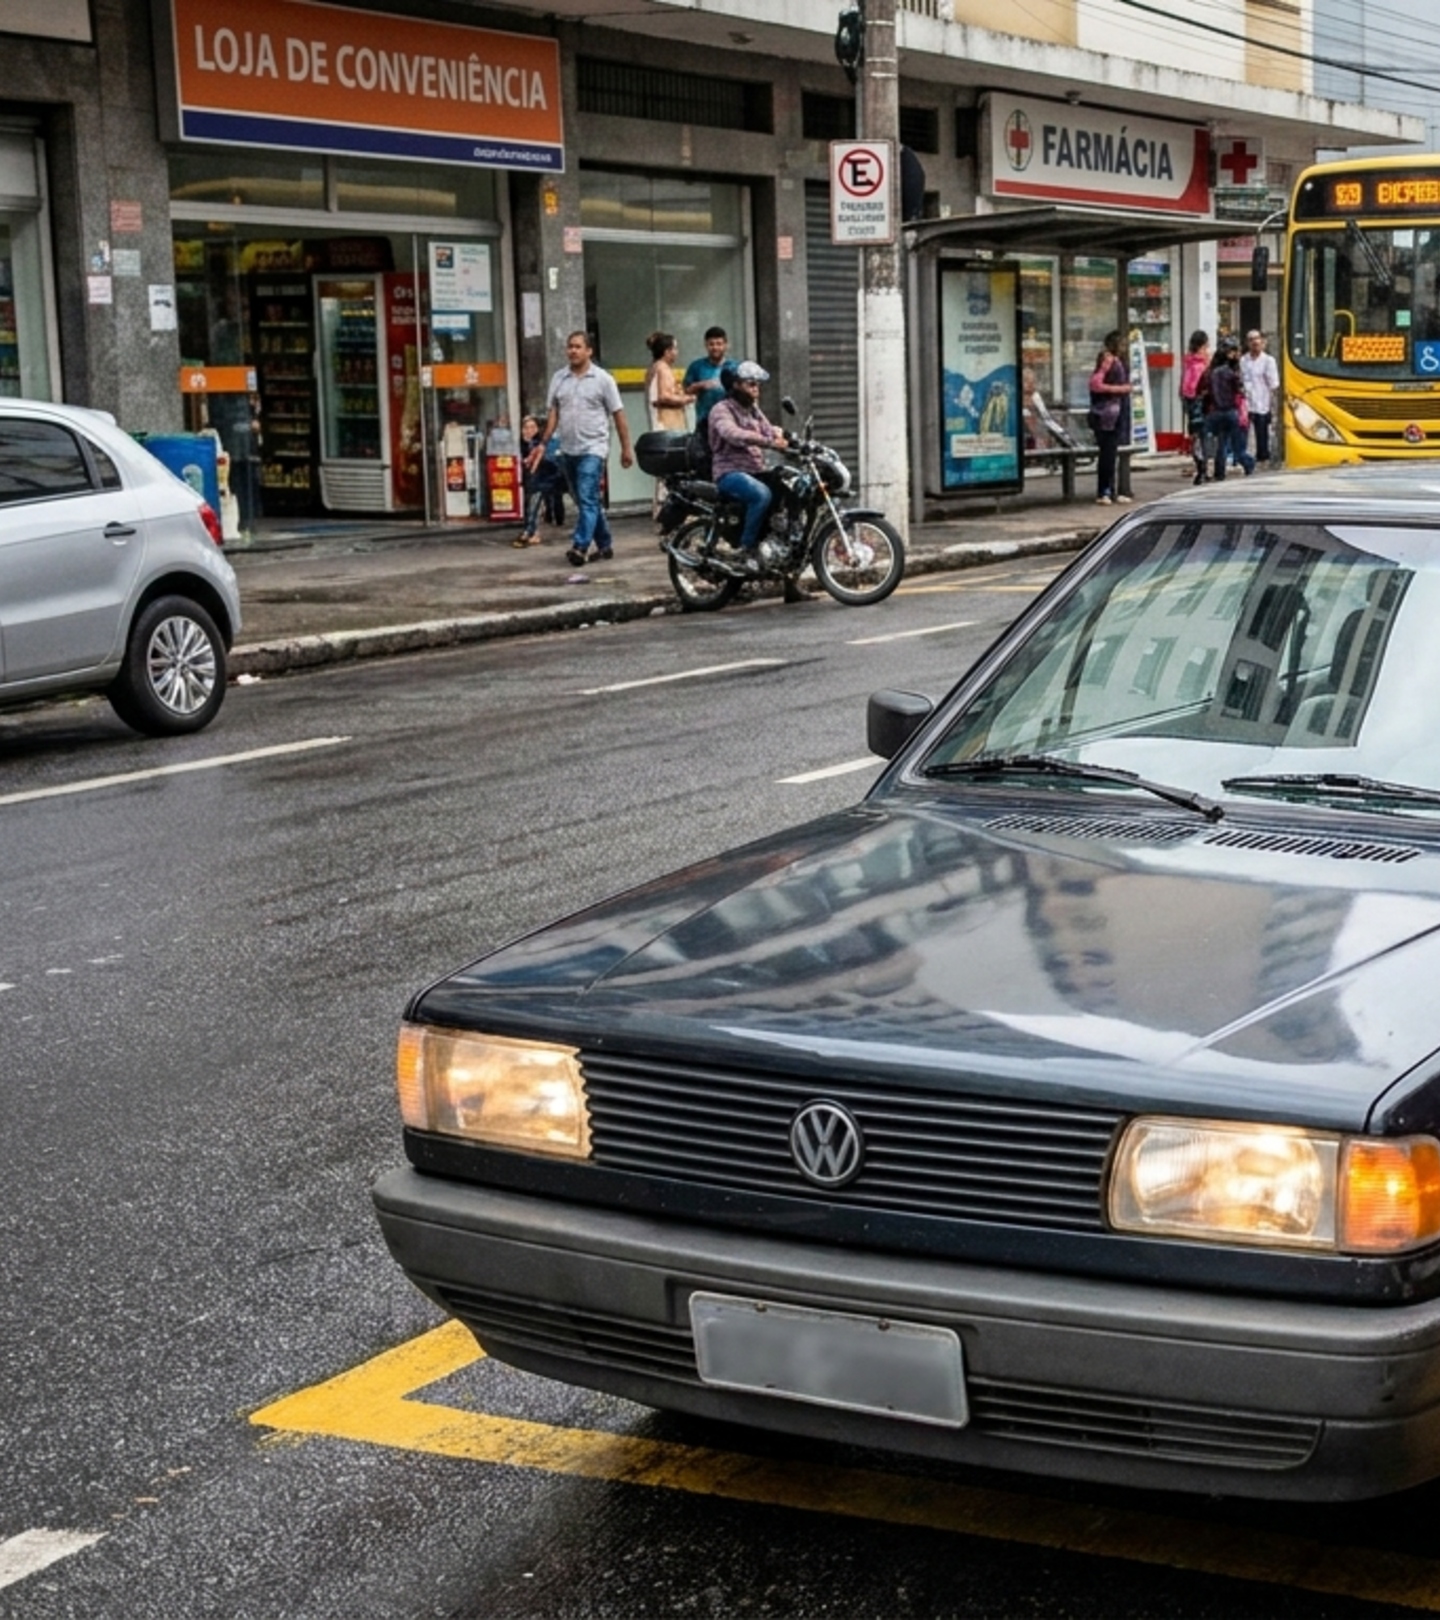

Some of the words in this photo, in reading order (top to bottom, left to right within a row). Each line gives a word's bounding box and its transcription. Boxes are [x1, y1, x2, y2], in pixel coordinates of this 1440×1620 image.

[195, 25, 278, 79] LOJA
[286, 37, 329, 85] DE
[336, 44, 548, 110] CONVENIÊNCIA
[847, 157, 875, 187] E
[1042, 124, 1173, 181] FARMÁCIA
[793, 1104, 858, 1181] VW
